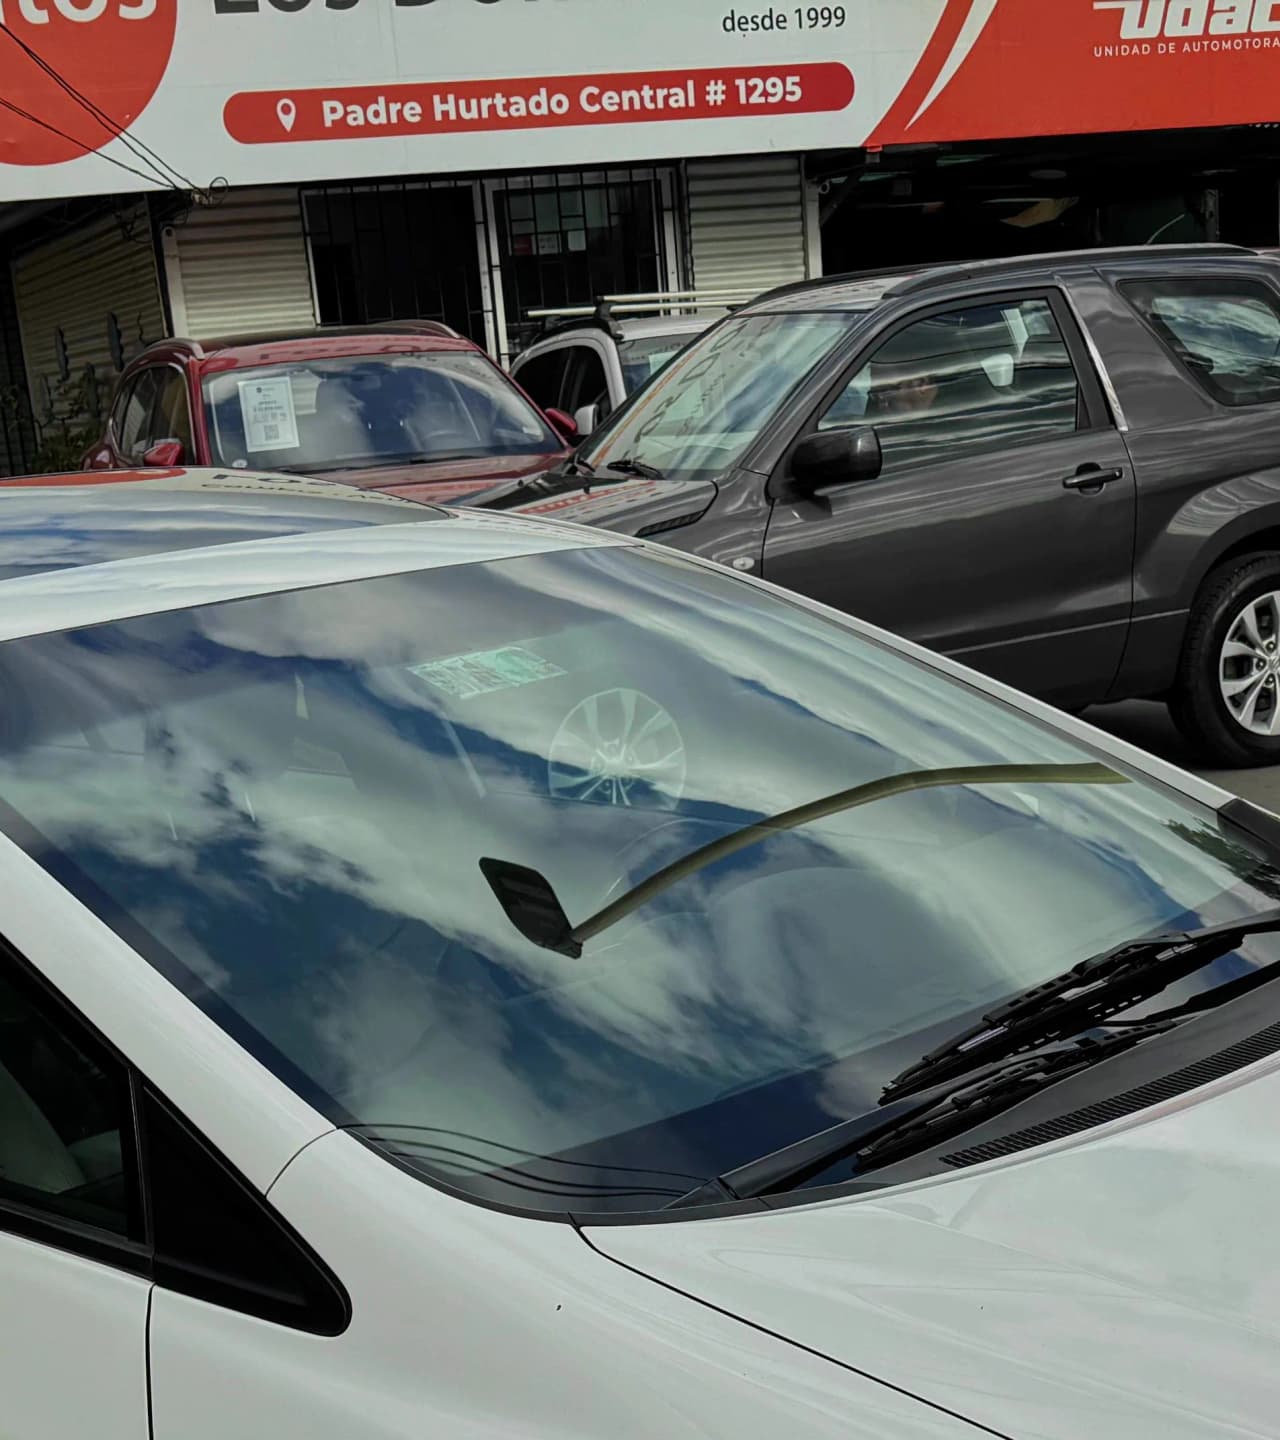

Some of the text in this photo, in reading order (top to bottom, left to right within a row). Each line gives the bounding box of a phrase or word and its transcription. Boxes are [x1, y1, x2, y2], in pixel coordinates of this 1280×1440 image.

[722, 7, 846, 32] desde 1999
[1094, 44, 1150, 57] UNIDAD
[1158, 42, 1176, 54] DE
[323, 76, 802, 128] Padre Hurtado Central # 1295
